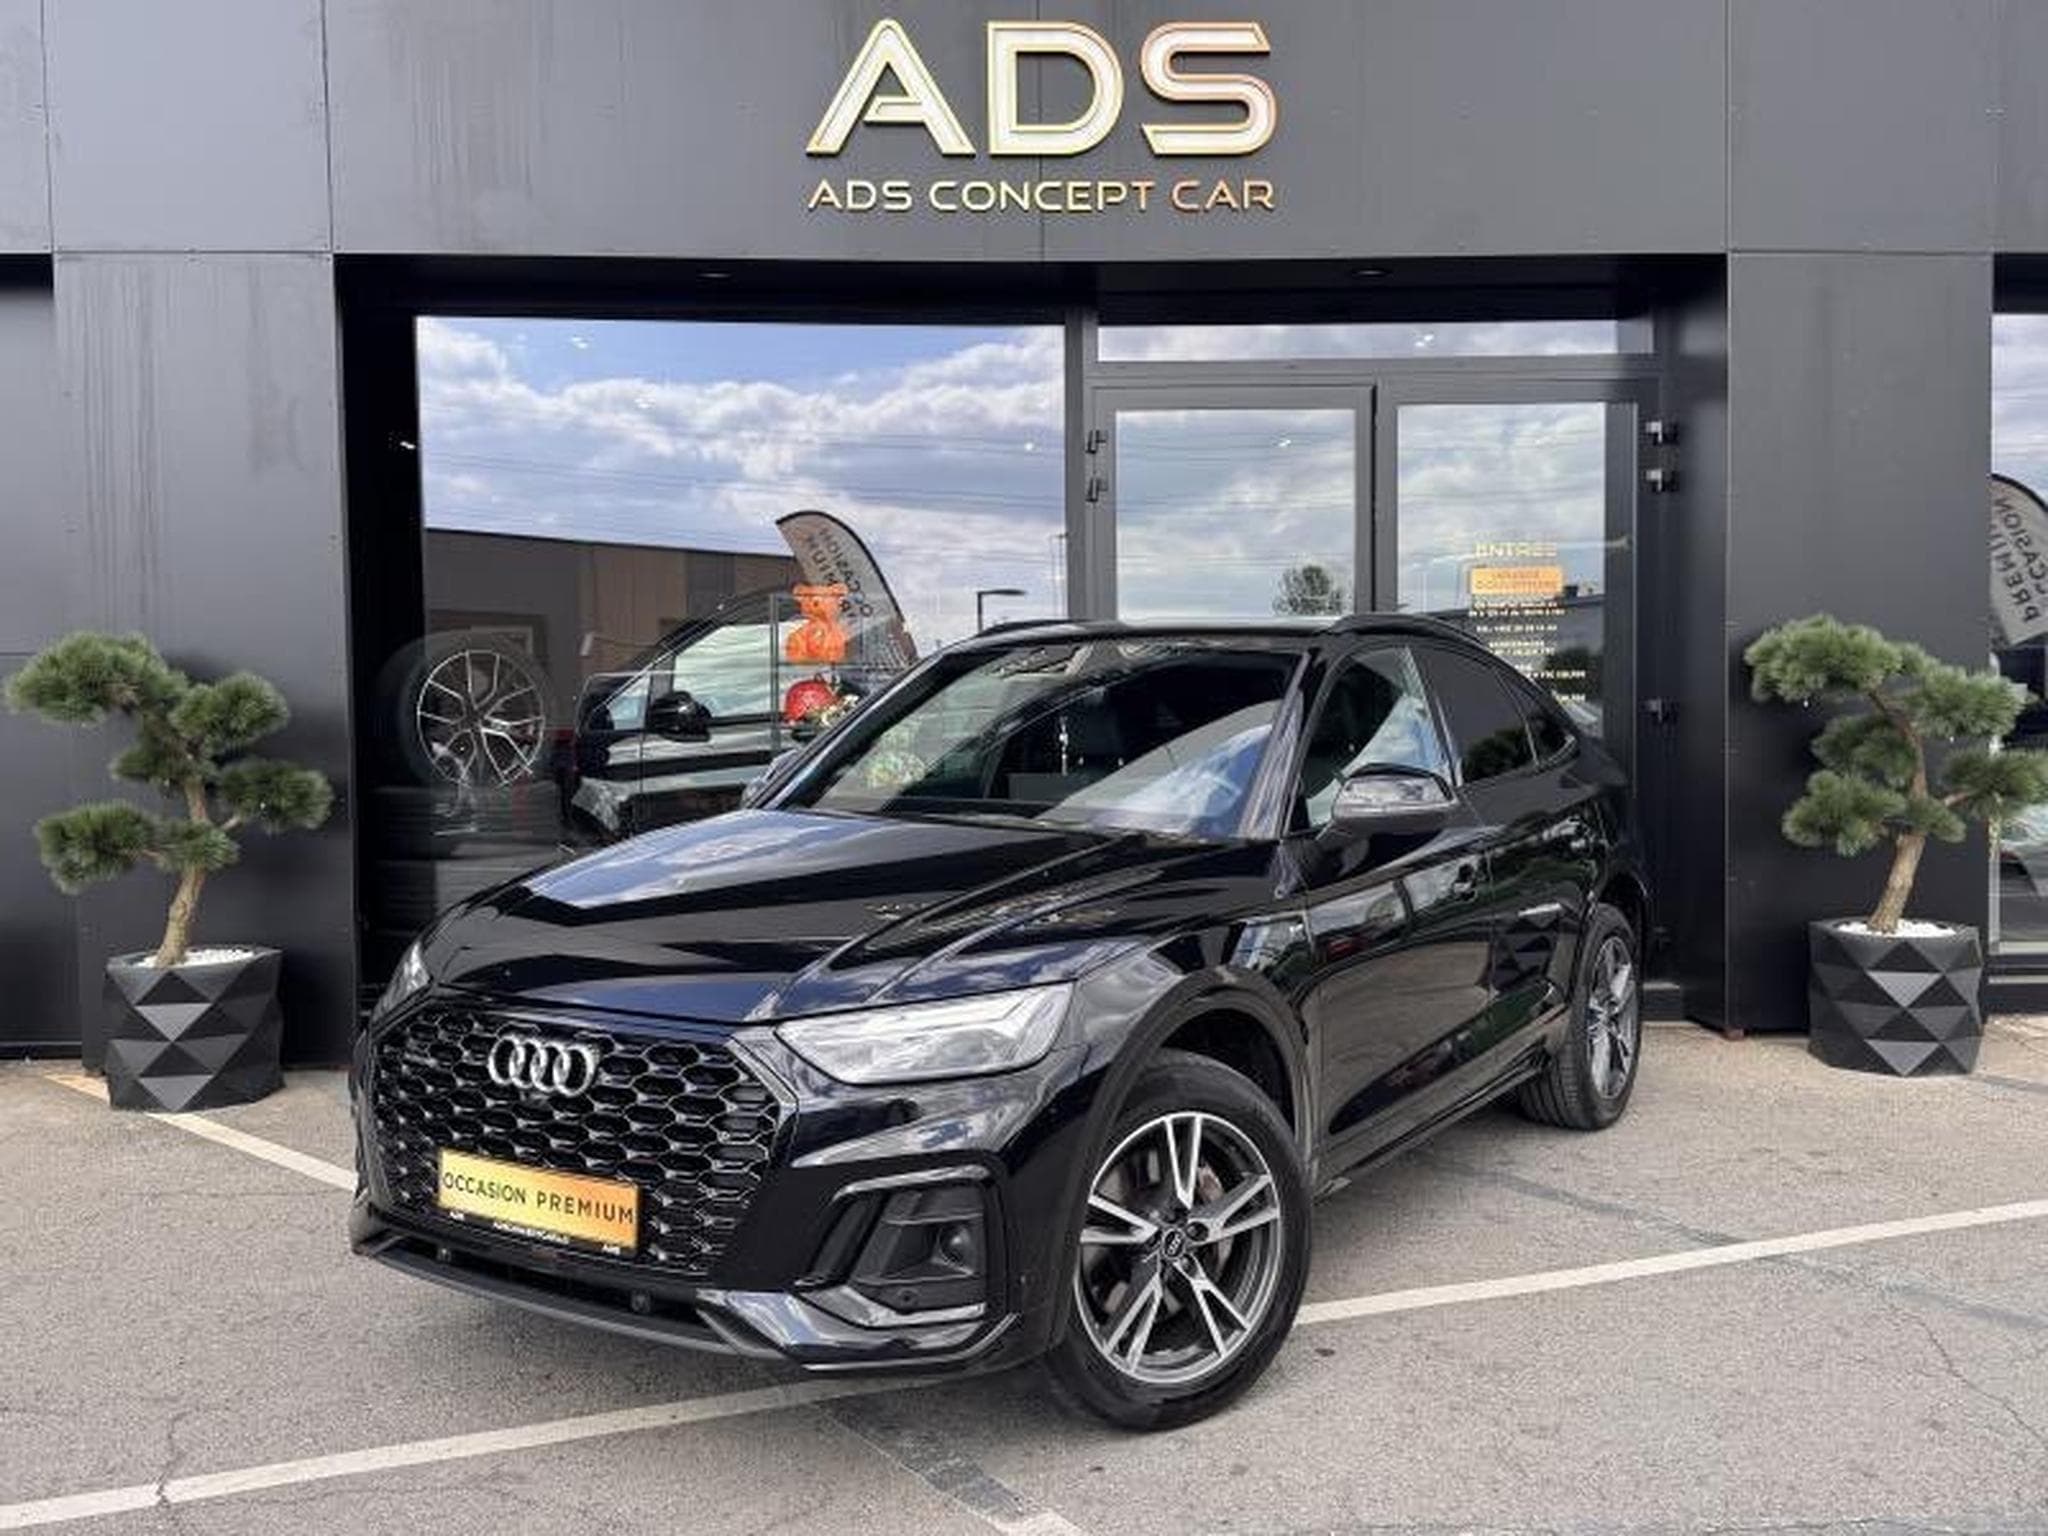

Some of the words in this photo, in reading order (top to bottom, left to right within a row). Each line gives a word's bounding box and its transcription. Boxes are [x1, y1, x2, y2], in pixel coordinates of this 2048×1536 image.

[805, 18, 1279, 156] ADS
[808, 179, 913, 211] ADS
[929, 180, 1155, 212] CONCEPT
[1171, 179, 1275, 212] CAR
[442, 1171, 526, 1204] OCCASION
[536, 1190, 635, 1225] PREMIUM
